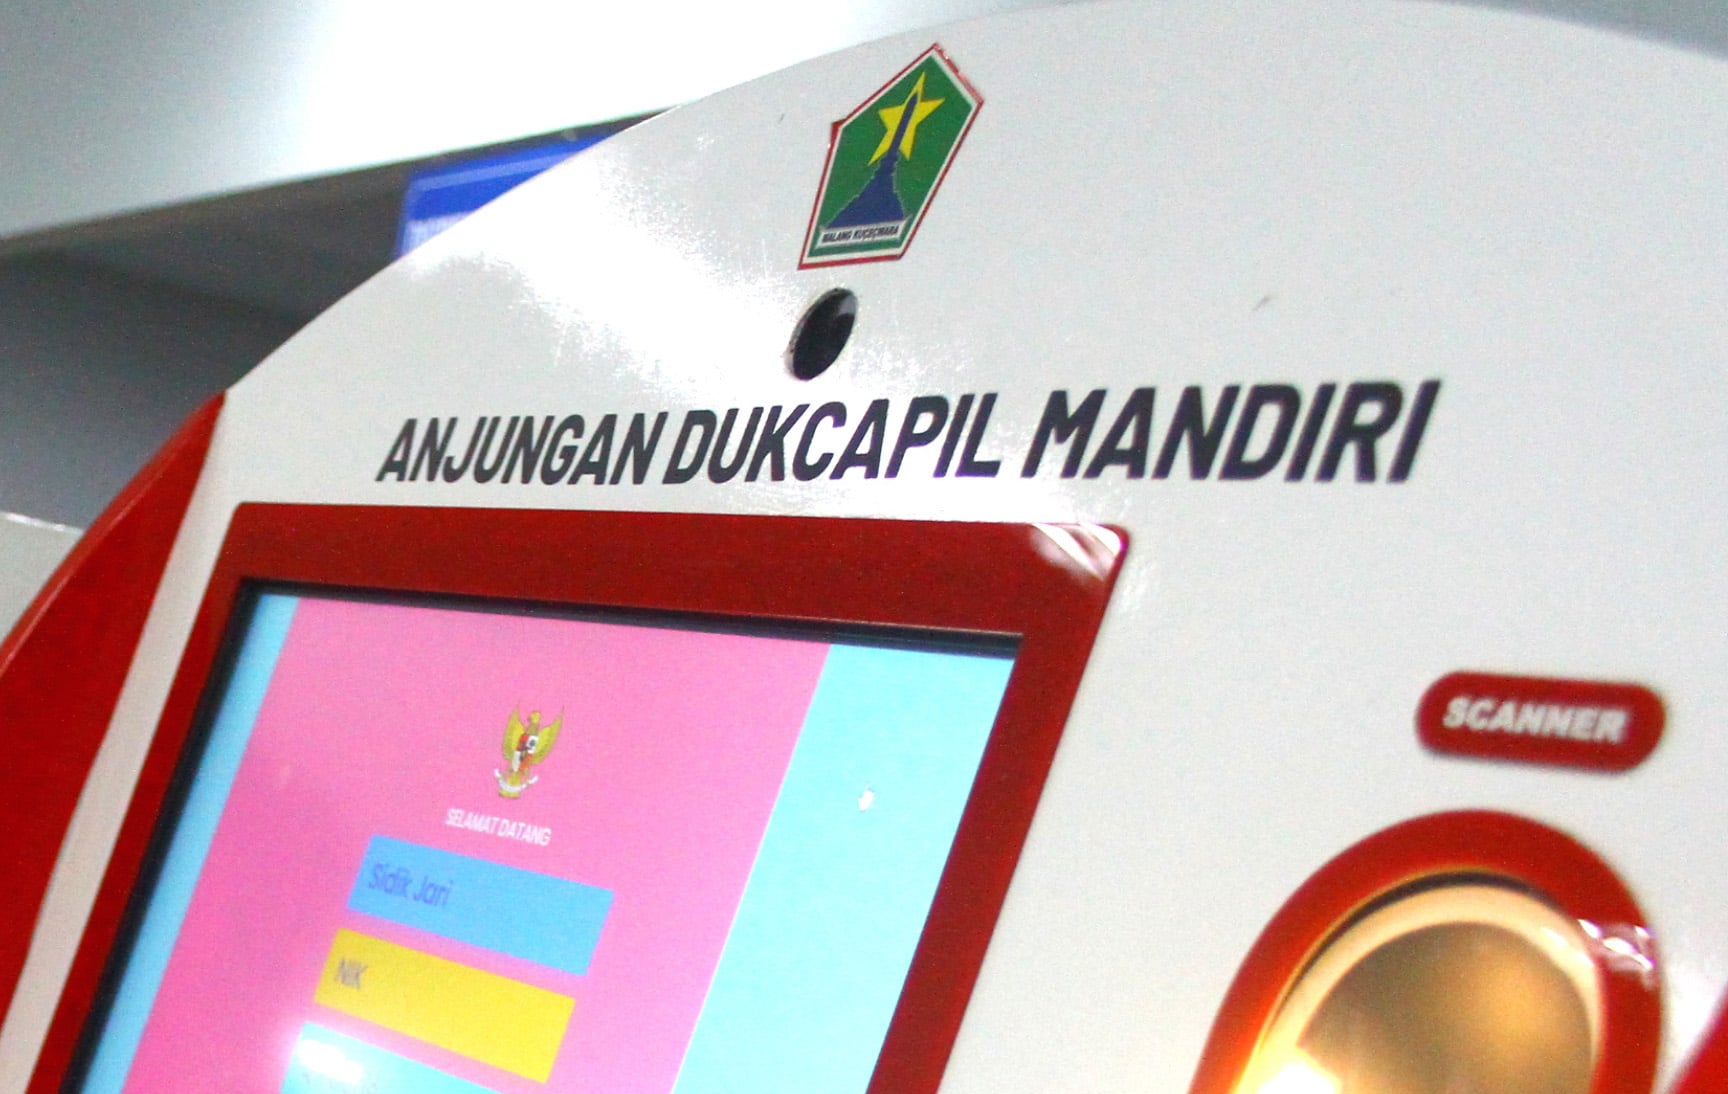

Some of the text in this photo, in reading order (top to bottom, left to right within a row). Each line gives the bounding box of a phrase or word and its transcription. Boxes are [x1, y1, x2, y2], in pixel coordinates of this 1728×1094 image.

[375, 379, 1443, 485] ANJUNGAN DUKCAPIL MANDIRI
[1441, 695, 1628, 745] SCANNER
[445, 807, 552, 846] SELAMAT DATANG
[412, 875, 454, 907] Jari
[334, 958, 368, 990] NIK
